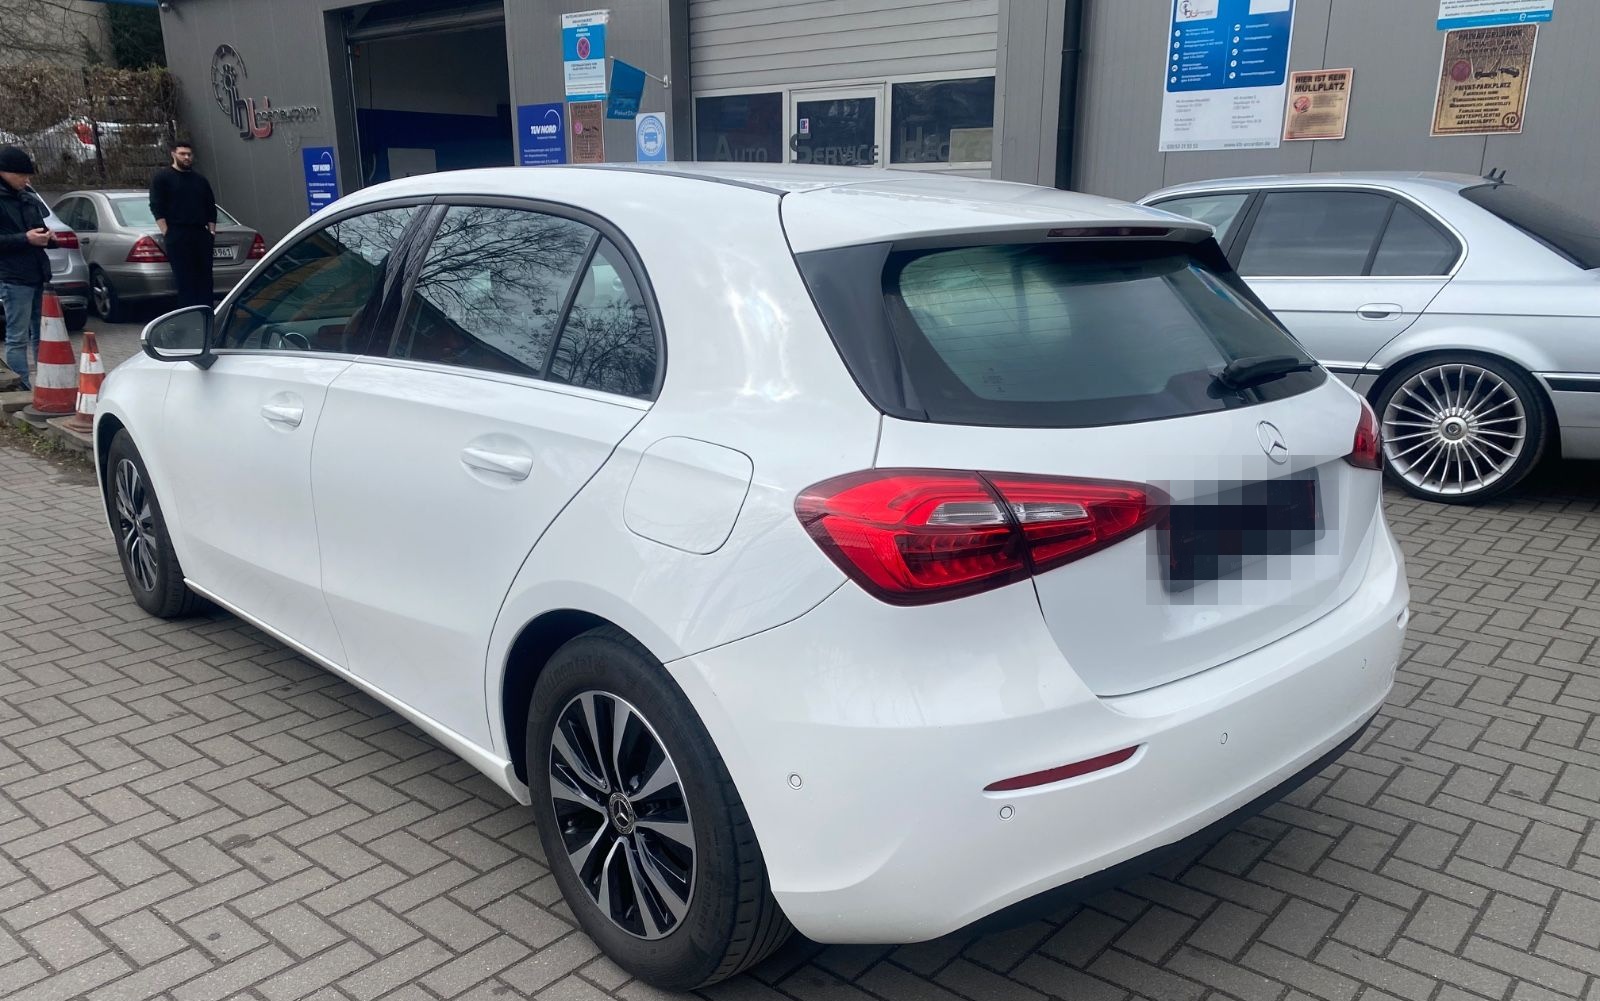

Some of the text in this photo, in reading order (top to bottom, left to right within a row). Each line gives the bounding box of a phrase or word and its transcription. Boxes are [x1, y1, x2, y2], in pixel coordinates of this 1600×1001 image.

[1295, 73, 1347, 83] HIER IST KEIN
[1294, 82, 1345, 93] MÜLLPLATZ
[1505, 115, 1516, 124] 10
[541, 124, 557, 135] NORD
